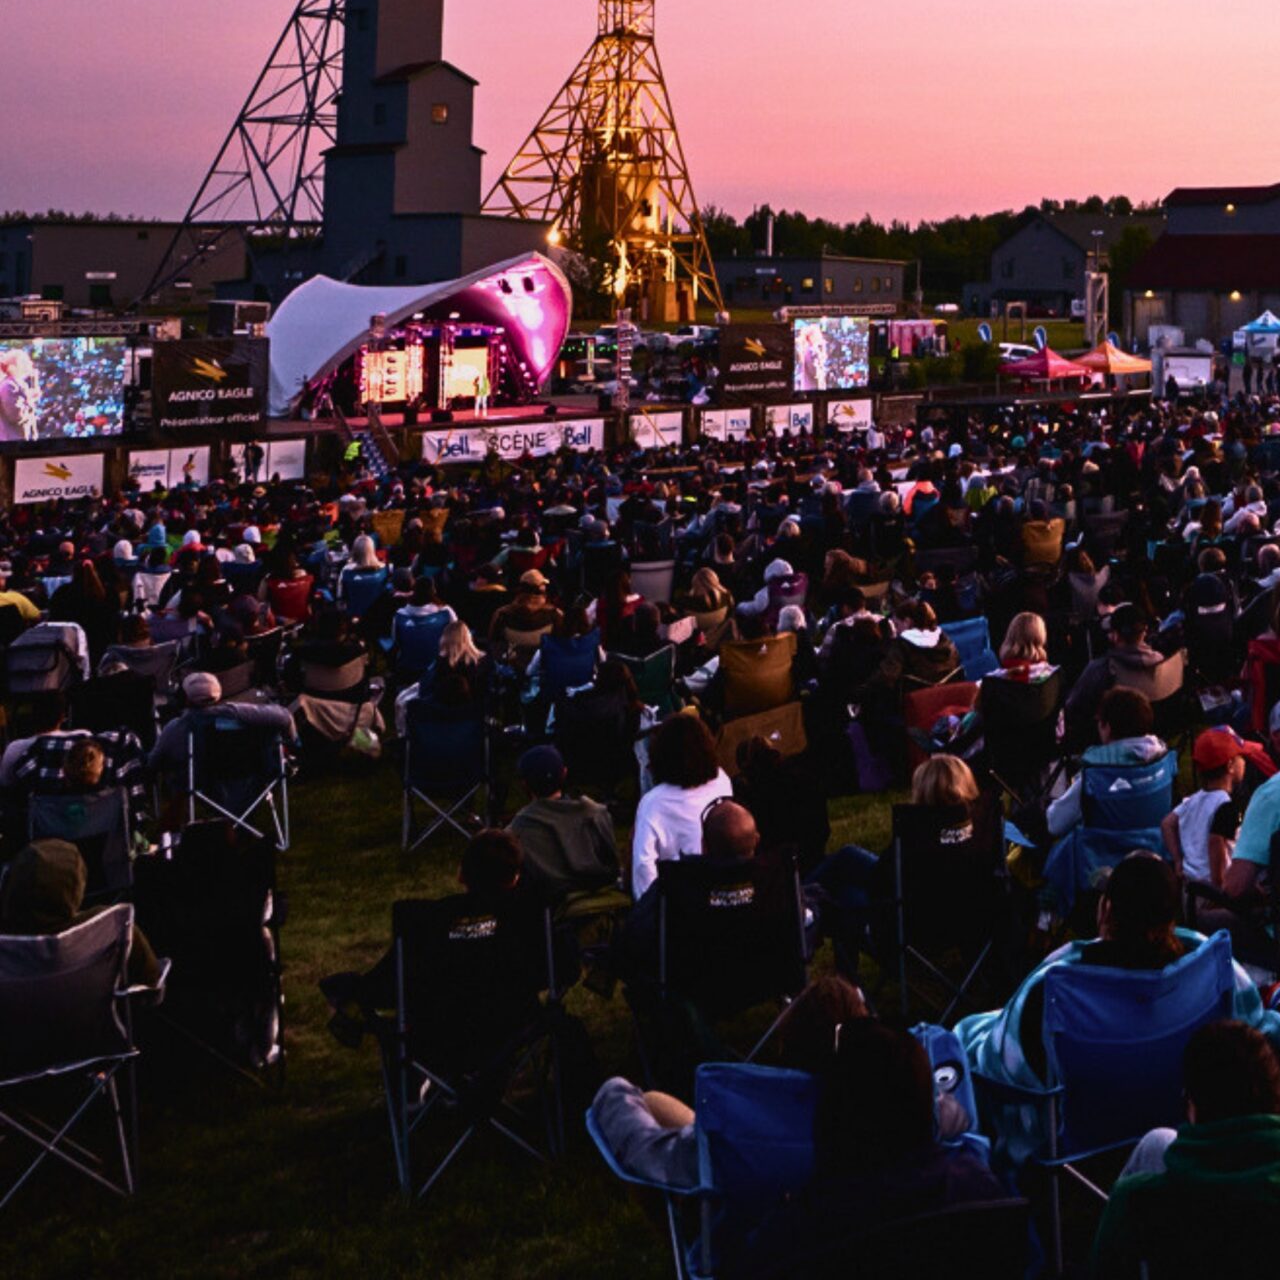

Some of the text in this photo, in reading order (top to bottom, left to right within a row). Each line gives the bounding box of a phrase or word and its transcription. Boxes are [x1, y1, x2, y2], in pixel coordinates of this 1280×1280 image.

[168, 386, 254, 402] AGNICO EAGLE
[437, 435, 470, 457] Bell
[488, 430, 546, 453] SCÈNE
[564, 425, 592, 446] Bell
[22, 484, 95, 498] AGNICO EAGLE
